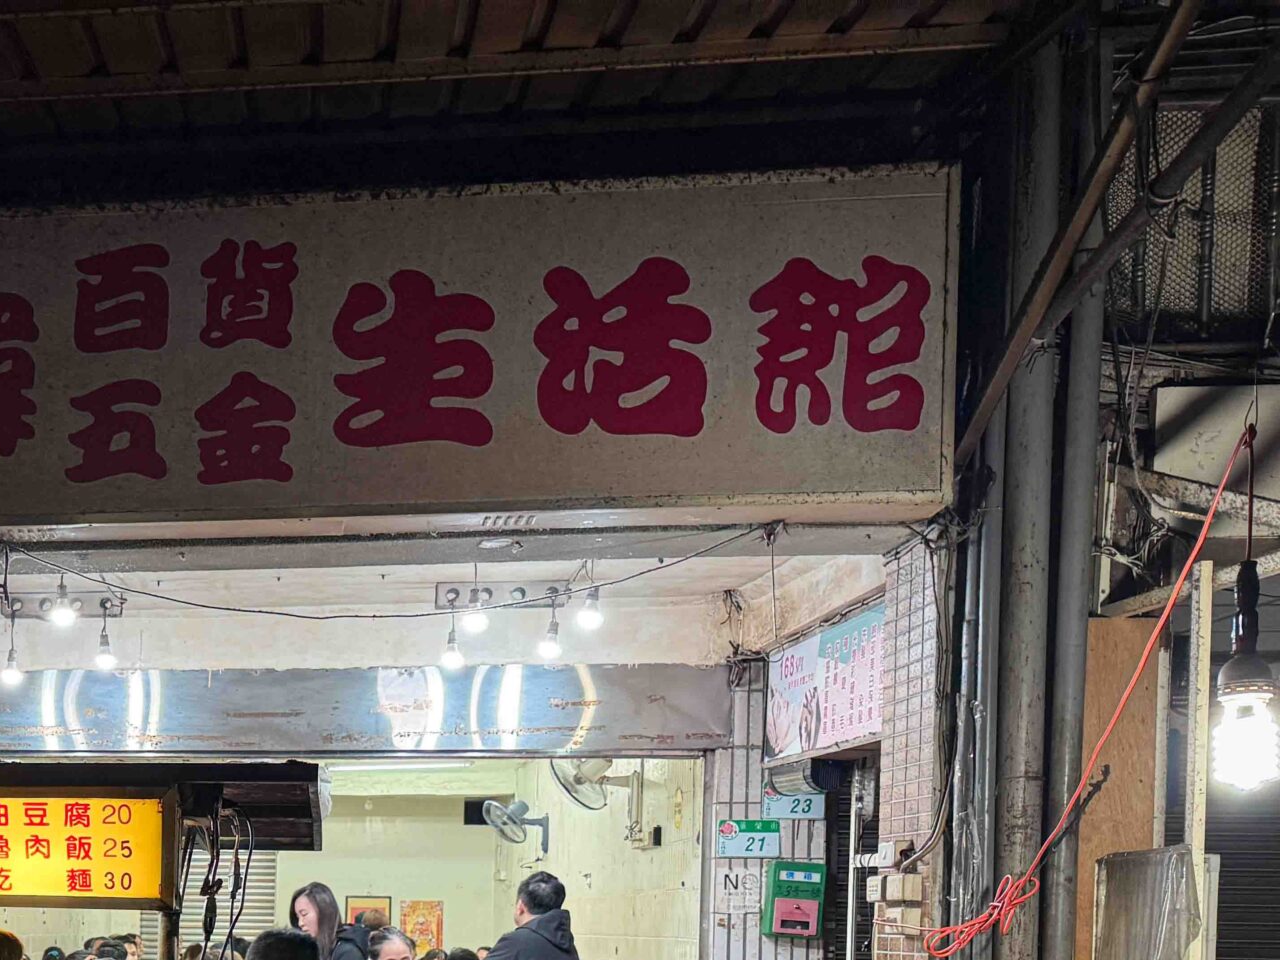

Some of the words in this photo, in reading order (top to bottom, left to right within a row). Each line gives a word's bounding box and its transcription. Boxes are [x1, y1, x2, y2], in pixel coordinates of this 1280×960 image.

[72, 237, 299, 354] 百貨
[332, 256, 931, 448] 生活館
[65, 371, 297, 486] 五金
[101, 804, 132, 825] 20
[789, 798, 813, 814] 23
[102, 837, 133, 859] 25
[744, 836, 767, 852] 21
[103, 871, 132, 891] 30
